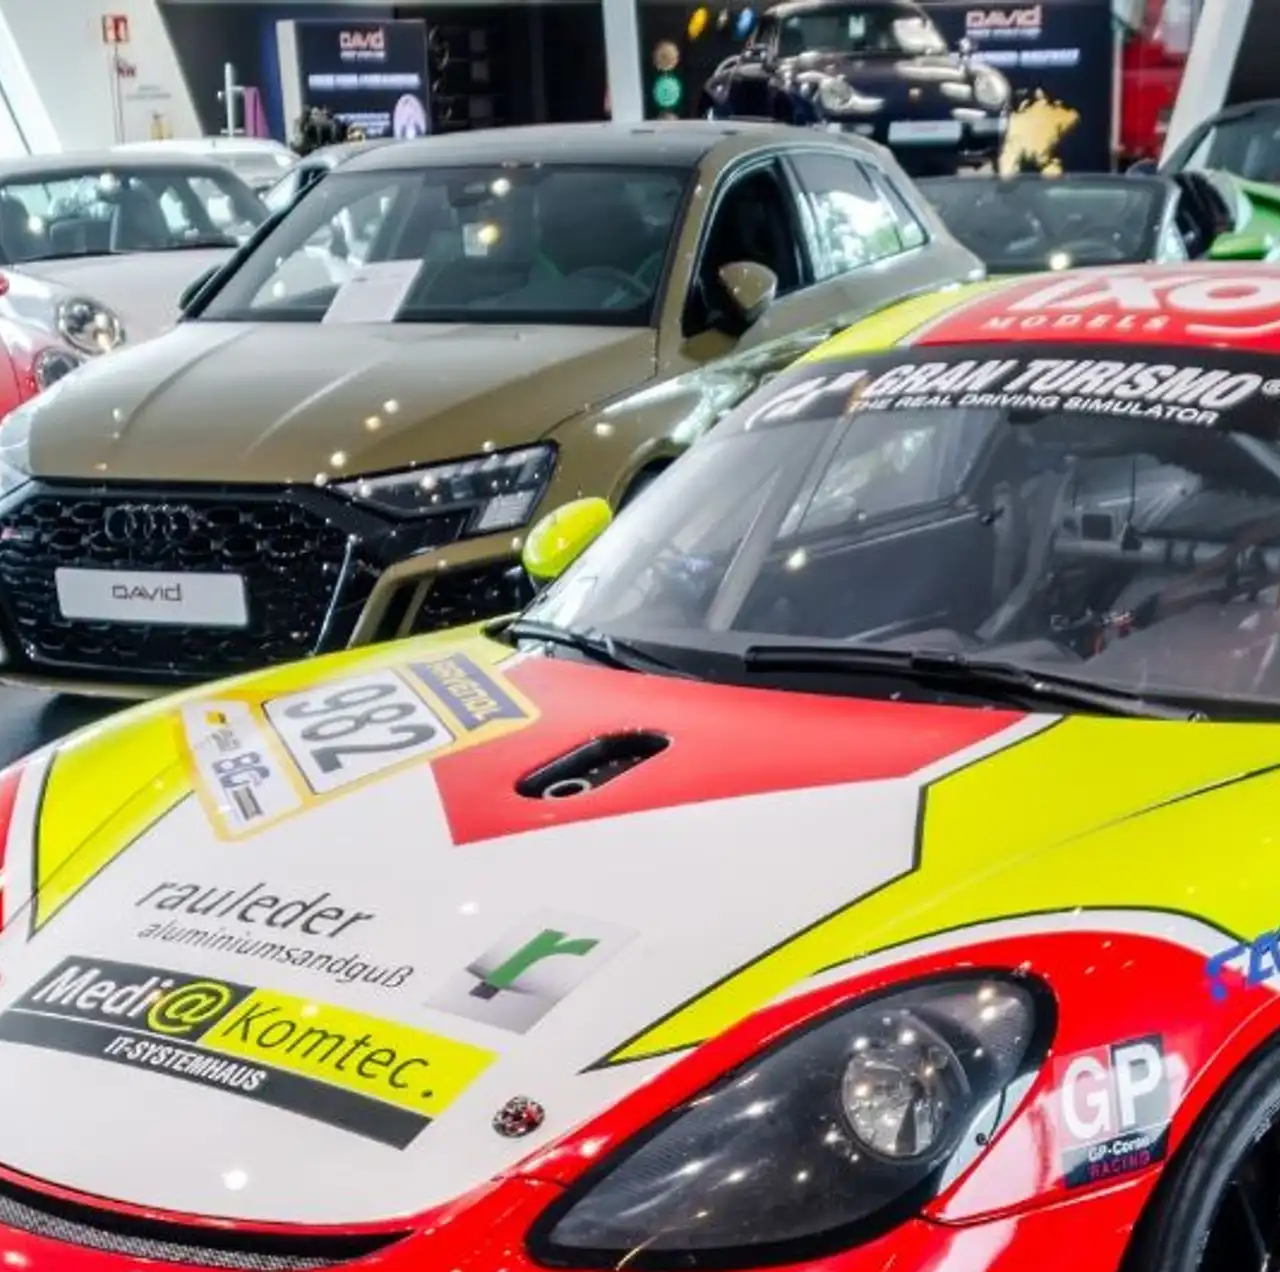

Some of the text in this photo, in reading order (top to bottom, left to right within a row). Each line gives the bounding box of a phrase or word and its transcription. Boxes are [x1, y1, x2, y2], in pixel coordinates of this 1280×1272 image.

[980, 314, 1170, 332] MODELS
[862, 359, 1020, 397] GRAN
[894, 394, 952, 408] REAL
[959, 393, 1058, 408] DRIVING
[1062, 397, 1219, 426] SIMULATOR
[283, 683, 437, 774] 982
[134, 881, 377, 939] rauleder
[137, 920, 415, 989] aluminiumsandguß
[102, 1036, 267, 1091] IT-SYSTEMHAUS
[1062, 1043, 1162, 1139] GP
